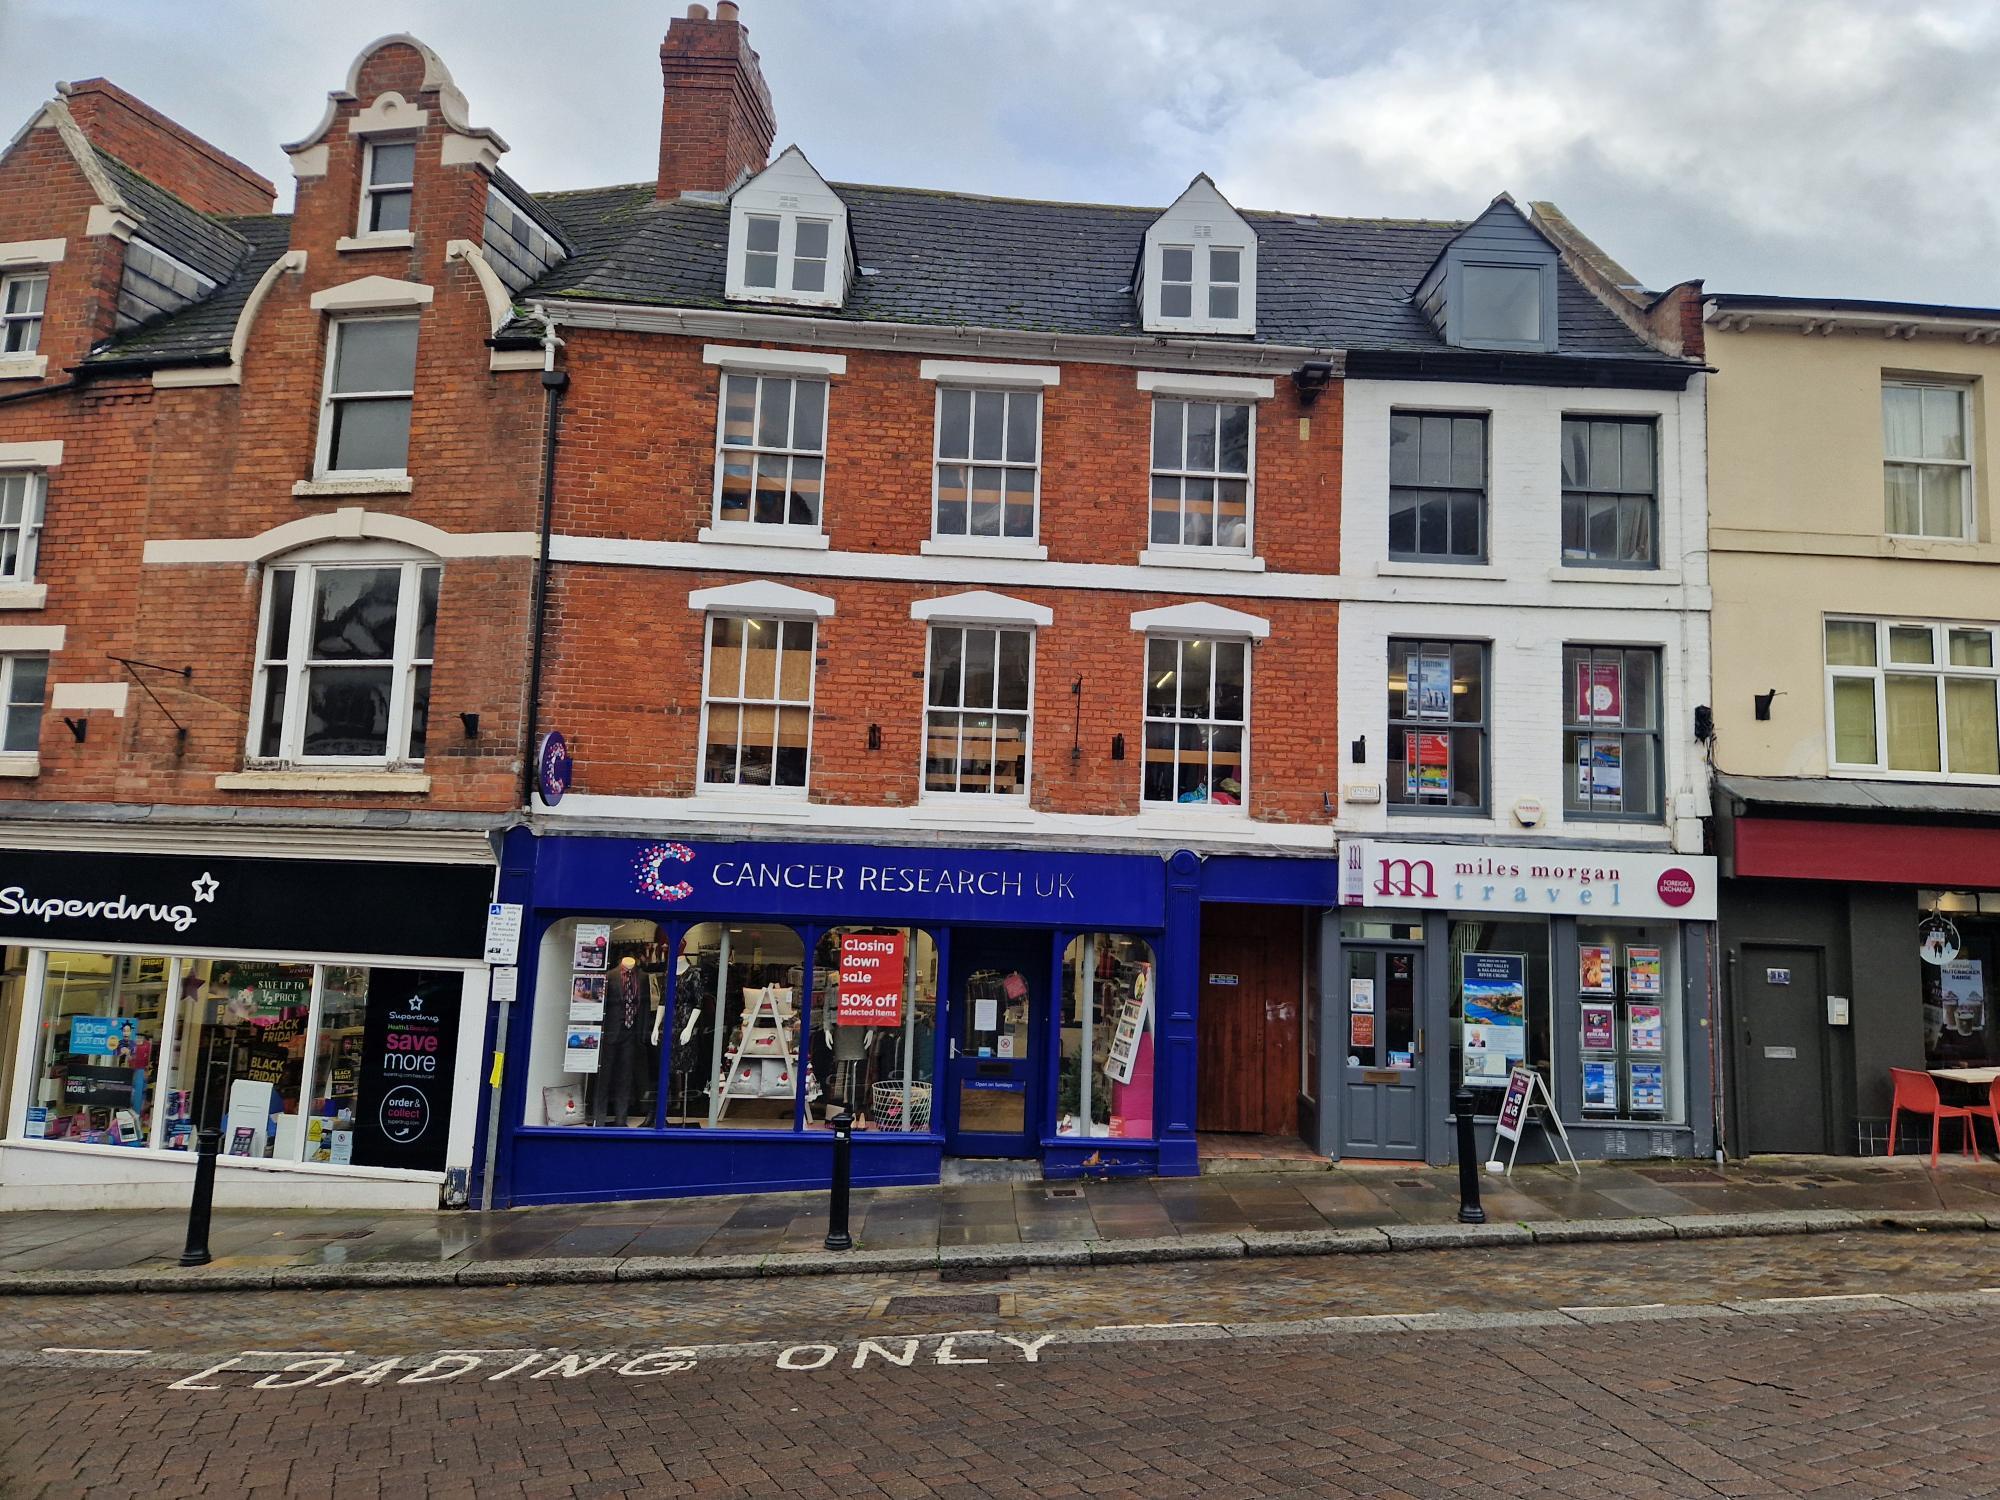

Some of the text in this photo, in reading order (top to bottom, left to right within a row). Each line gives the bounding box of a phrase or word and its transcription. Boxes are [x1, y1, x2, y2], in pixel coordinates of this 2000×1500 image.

[1455, 858, 1620, 885] miles morgan
[712, 862, 1075, 899] CANCER RESEARCH UK
[1663, 879, 1689, 887] FOREIGN
[1454, 881, 1621, 906] travel
[1660, 885, 1693, 893] EXCHANGE
[0, 886, 197, 932] Superdrug
[844, 939, 894, 954] Closing
[843, 955, 880, 967] down
[842, 971, 872, 983] sale
[258, 980, 304, 990] SAVE UP TO
[274, 993, 298, 1002] PRICE
[841, 993, 898, 1007] 50% off
[389, 1011, 439, 1023] Superdrug
[840, 1008, 897, 1017] selected items
[262, 1031, 298, 1042] FRIDAY
[386, 1033, 438, 1051] save
[250, 1056, 285, 1071] BLACK
[383, 1052, 436, 1072] more
[248, 1069, 283, 1084] FRIDAY
[66, 1085, 86, 1094] MORE
[389, 1098, 421, 1108] order &
[387, 1108, 420, 1119] collect
[167, 1335, 1056, 1390] LOADING ONLY
